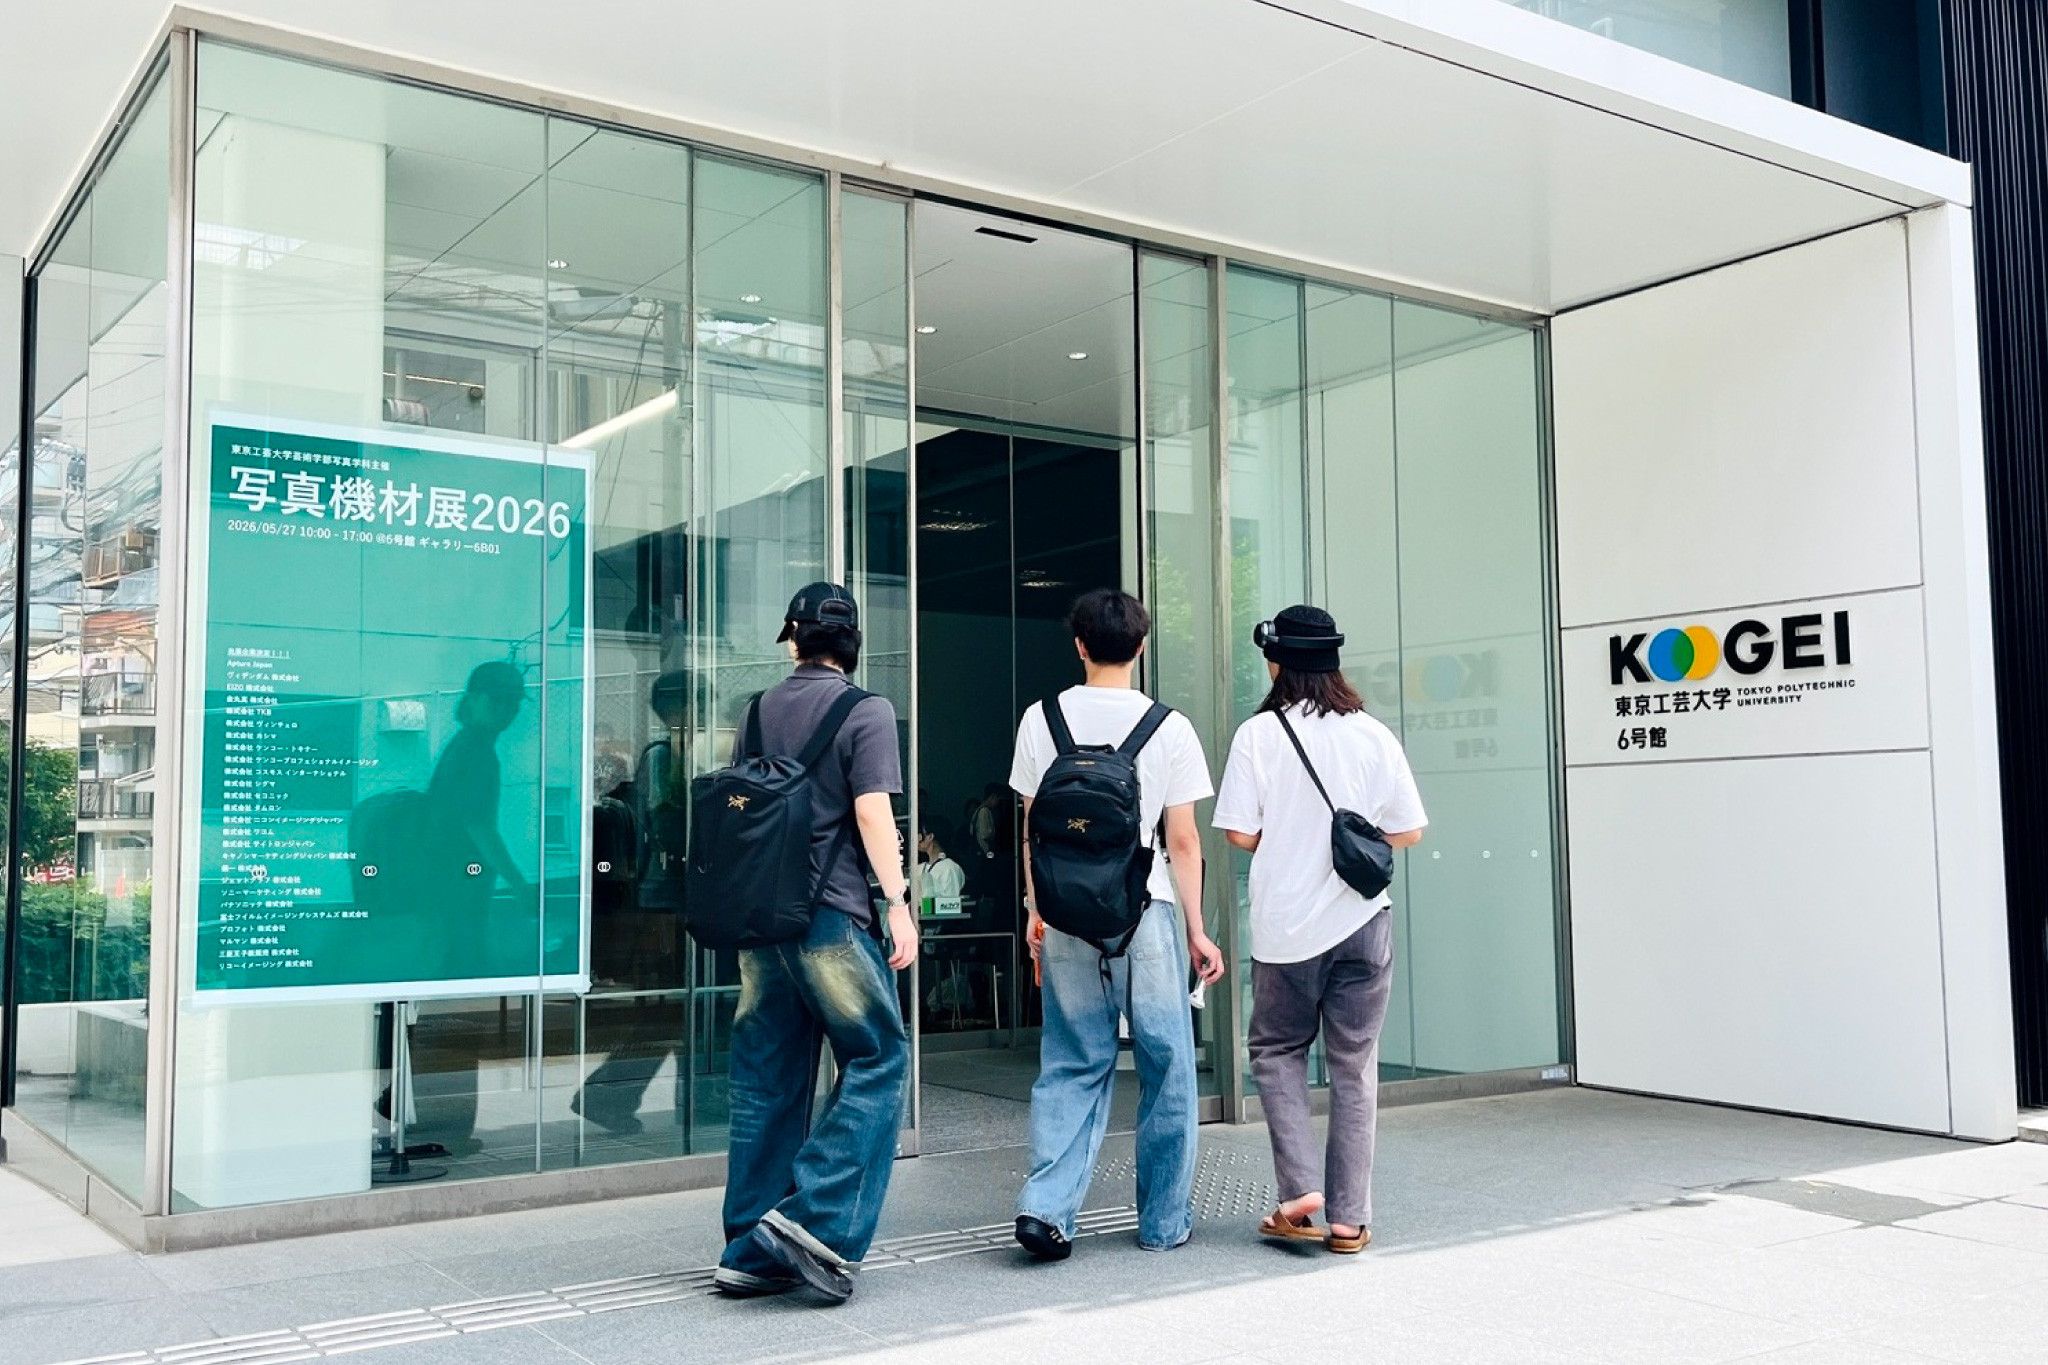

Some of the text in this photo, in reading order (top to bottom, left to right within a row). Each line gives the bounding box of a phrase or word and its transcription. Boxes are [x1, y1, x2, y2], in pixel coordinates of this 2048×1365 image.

[231, 444, 390, 471] 東京工芸大学芸術学部写真学科主催
[228, 466, 571, 538] 写真機材展2026
[228, 520, 296, 536] 2026/05/27
[299, 524, 332, 539] 10:00
[342, 528, 374, 543] 17:00
[376, 531, 415, 547] @6号館
[419, 536, 500, 554] ギャラリー6B01
[1737, 679, 1856, 696] TOKYO POLYTECHNIC
[1615, 687, 1732, 717] 東京工芸大学
[1737, 694, 1802, 707] UNIVERSITY
[226, 719, 254, 728] 株式会社
[225, 731, 253, 739] 株式会社
[1617, 726, 1667, 750] 6号館
[225, 743, 253, 752] 株式会社
[224, 755, 253, 764] 株式会社
[224, 767, 252, 776] 株式会社
[224, 780, 252, 788] 株式会社
[223, 792, 252, 800] 株式会社
[223, 804, 251, 812] 株式会社
[223, 816, 251, 824] 株式会社
[223, 828, 251, 836] 株式会社
[222, 840, 251, 848] 株式会社
[329, 852, 357, 860] 株式会社
[273, 876, 301, 884] 株式会社
[293, 888, 321, 896] 株式会社
[265, 900, 293, 908] 株式会社
[257, 924, 286, 932] 株式会社
[271, 948, 299, 956] 株式会社
[285, 960, 313, 968] 株式会社
